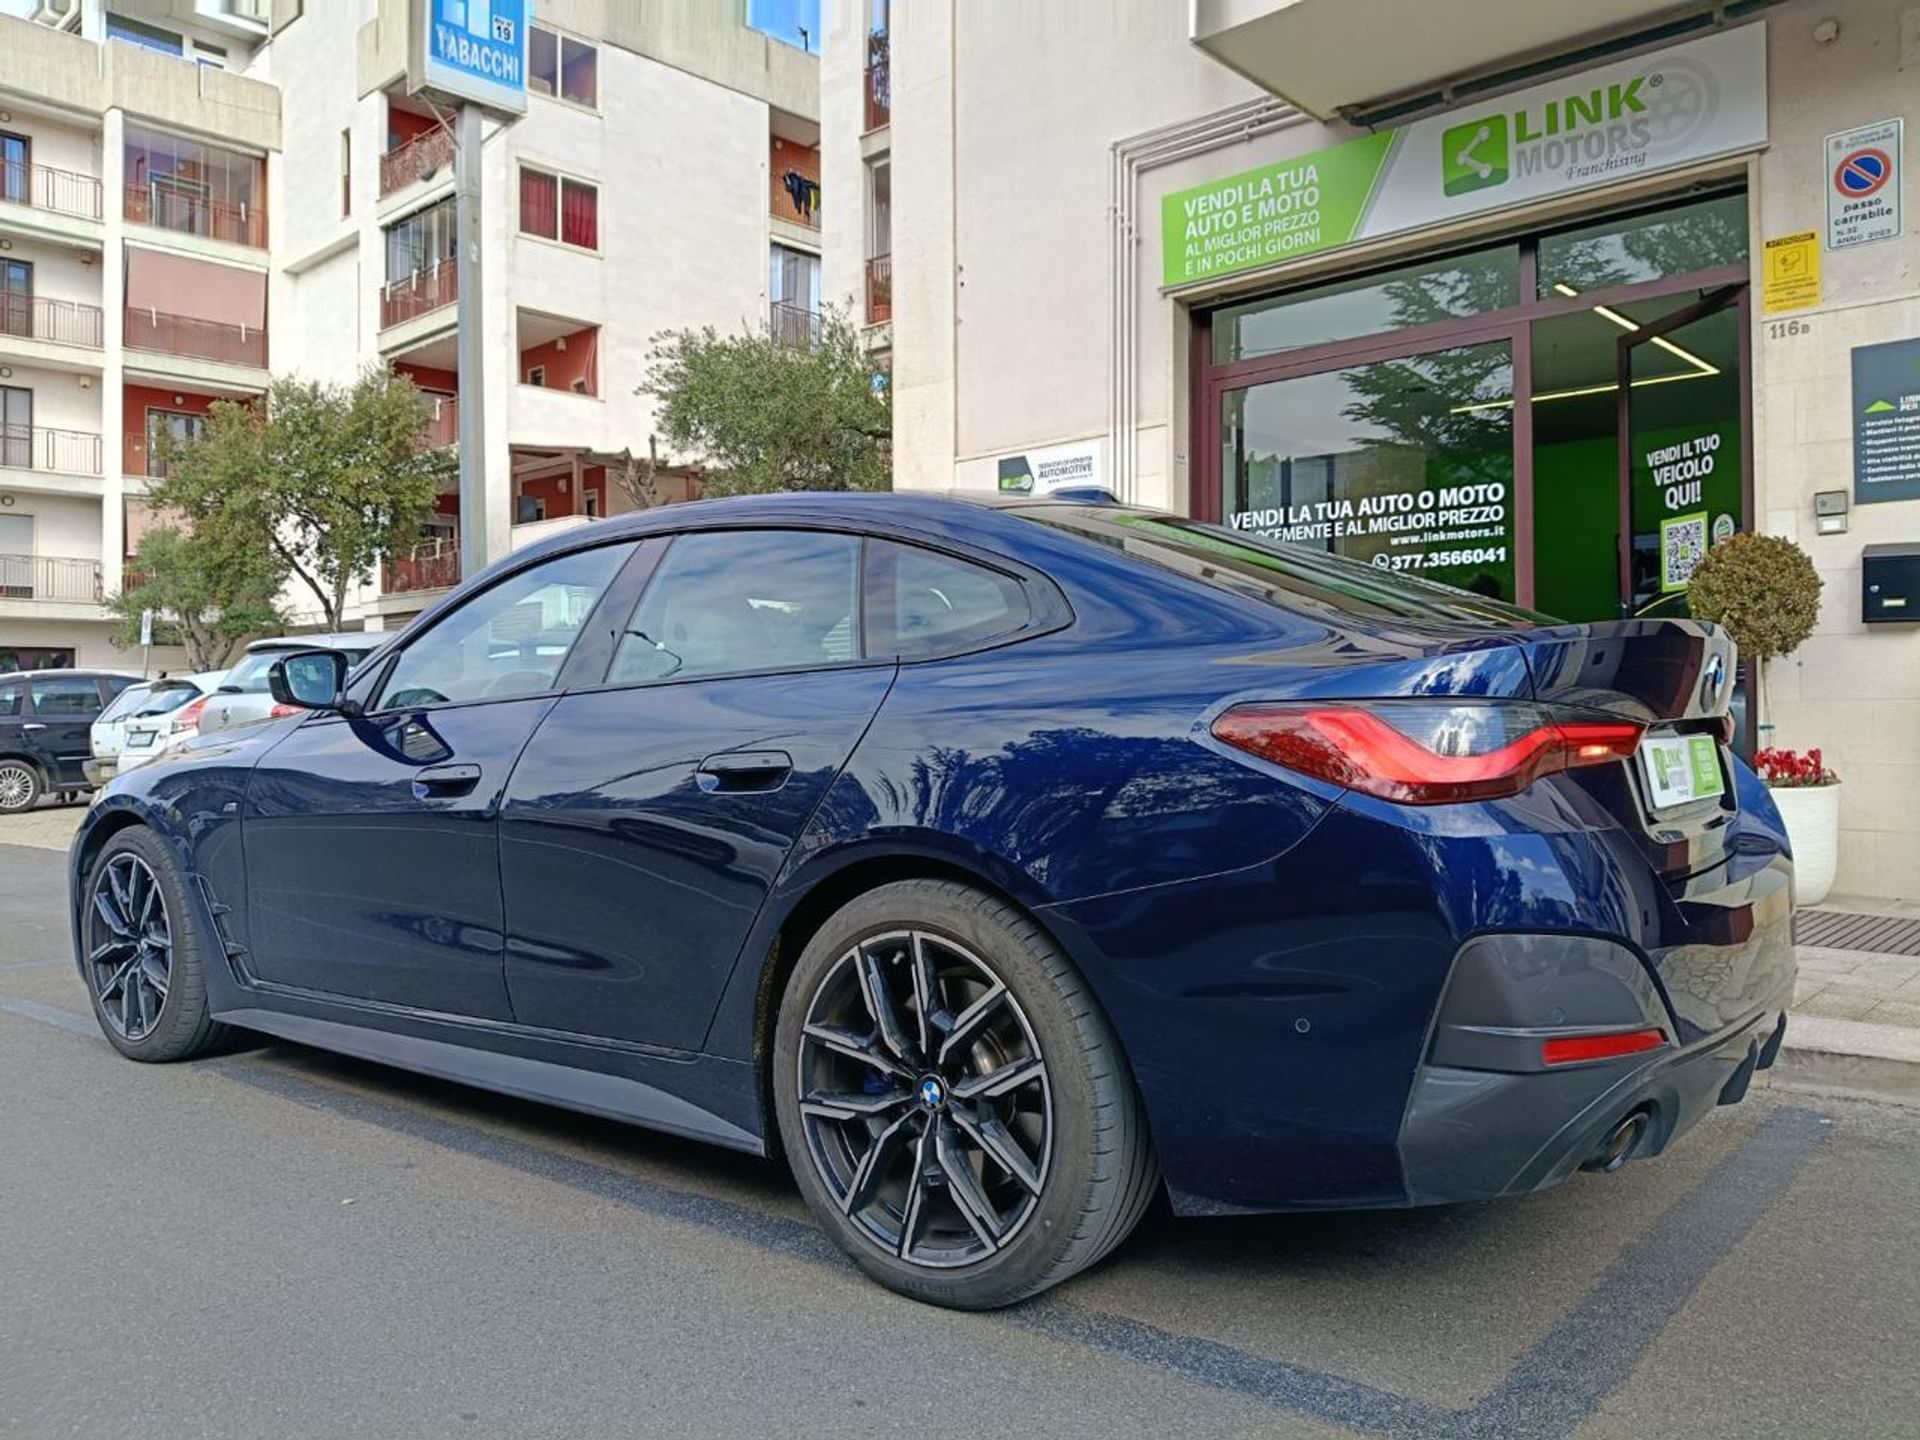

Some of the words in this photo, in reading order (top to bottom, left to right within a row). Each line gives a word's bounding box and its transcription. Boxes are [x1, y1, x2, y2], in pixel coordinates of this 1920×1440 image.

[497, 26, 511, 41] 19
[434, 23, 520, 83] TABACCHI
[1515, 75, 1647, 144] LINK
[1516, 117, 1650, 178] MOTORS
[1565, 151, 1647, 181] Franchising
[1184, 185, 1243, 218] VENDI
[1248, 177, 1272, 200] LA
[1277, 164, 1319, 191] TUA
[1844, 197, 1882, 213] passo
[1185, 209, 1237, 241] AUTO
[1242, 204, 1253, 224] E
[1258, 186, 1319, 220] MOTO
[1834, 206, 1893, 226] carrabile
[1185, 243, 1201, 258] AL
[1204, 225, 1261, 252] MIGLIOR
[1264, 210, 1320, 237] PREZZO
[1185, 259, 1193, 276] E
[1197, 255, 1211, 272] IN
[1216, 243, 1261, 267] POCHI
[1265, 228, 1320, 255] GIORNI
[1646, 445, 1681, 468] VENDI
[1682, 440, 1693, 458] IL
[1694, 433, 1720, 453] TUO
[1039, 463, 1093, 480] AUTOMOTIVE
[1653, 455, 1713, 486] VEICOLO
[1229, 507, 1284, 530] VENDI
[1288, 505, 1312, 524] LA
[1315, 500, 1354, 521] TUA
[1358, 493, 1414, 516] AUTO
[1418, 490, 1434, 509] O
[1439, 482, 1505, 508] MOTO
[1665, 480, 1702, 510] QUI!
[1334, 521, 1344, 537] E
[1346, 519, 1366, 536] AL
[1368, 512, 1436, 534] MIGLIOR
[1438, 505, 1504, 526] PREZZO
[1390, 525, 1505, 546] www.linkmotors.it
[1391, 547, 1506, 570] 377.3566041
